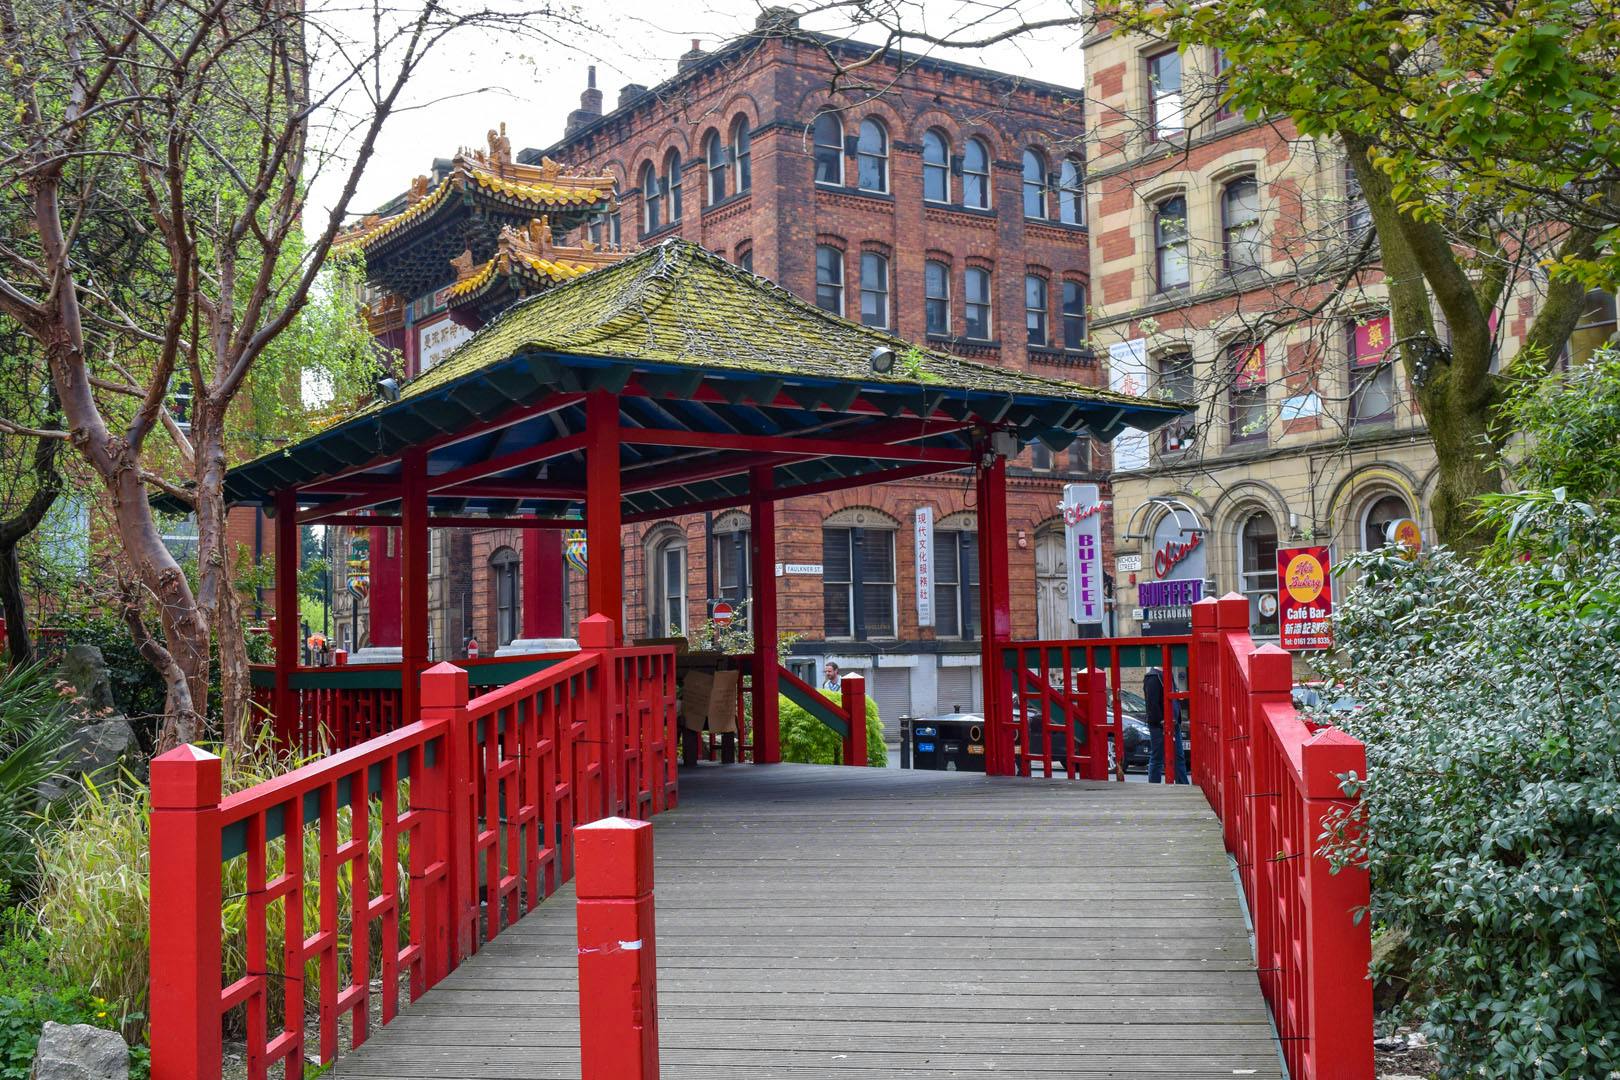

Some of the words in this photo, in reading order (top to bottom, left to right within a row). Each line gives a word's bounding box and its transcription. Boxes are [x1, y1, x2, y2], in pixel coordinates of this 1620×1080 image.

[1064, 501, 1105, 528] China
[1154, 531, 1200, 579] China
[1078, 534, 1095, 617] BUFFET
[1138, 579, 1201, 608] BUFFET
[1148, 608, 1192, 620] RESTAURAN
[1286, 606, 1308, 620] Café
[1309, 607, 1326, 619] Bar
[1293, 637, 1306, 646] 0161
[1306, 637, 1317, 645] 236
